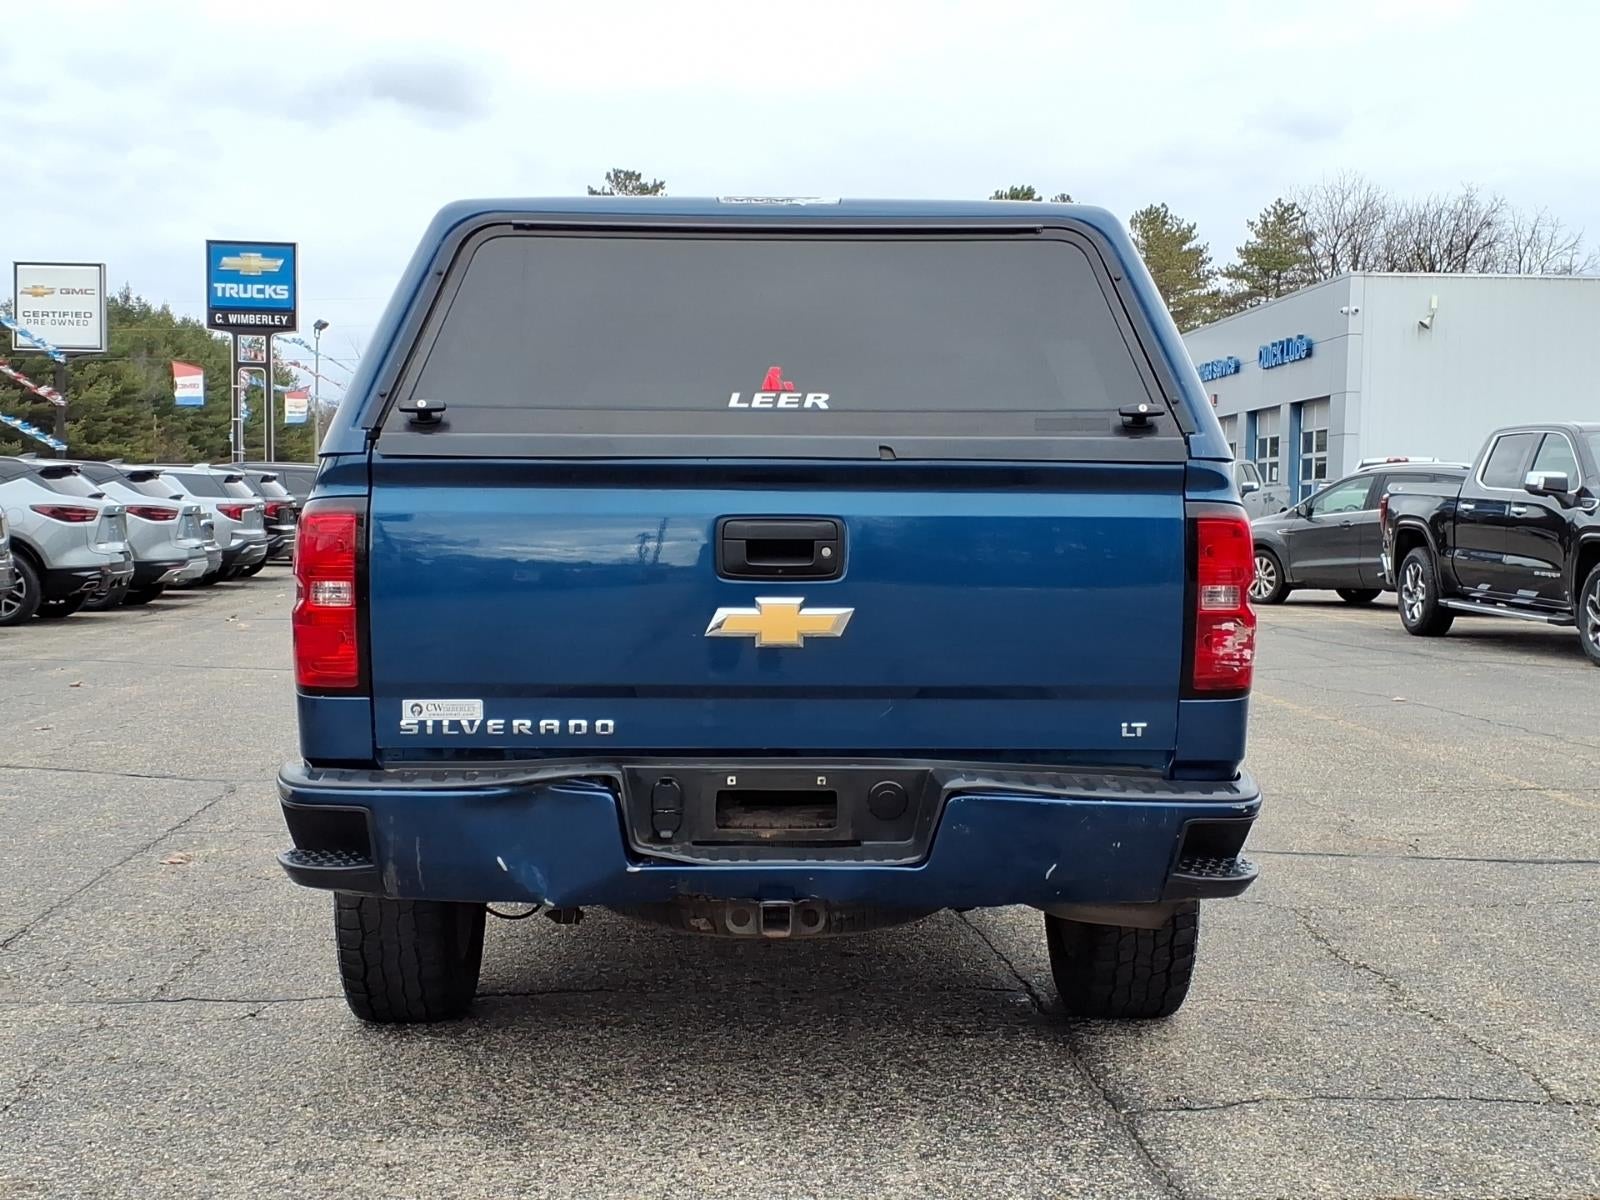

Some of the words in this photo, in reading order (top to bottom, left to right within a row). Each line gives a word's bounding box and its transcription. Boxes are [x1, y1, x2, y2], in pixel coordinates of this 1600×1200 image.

[213, 283, 289, 299] TRUCKS
[22, 310, 93, 318] CERTIFIED
[228, 313, 288, 325] WIMBERLEY
[728, 392, 830, 409] LEER
[400, 719, 614, 735] SILVERADO
[1121, 722, 1147, 737] LT
